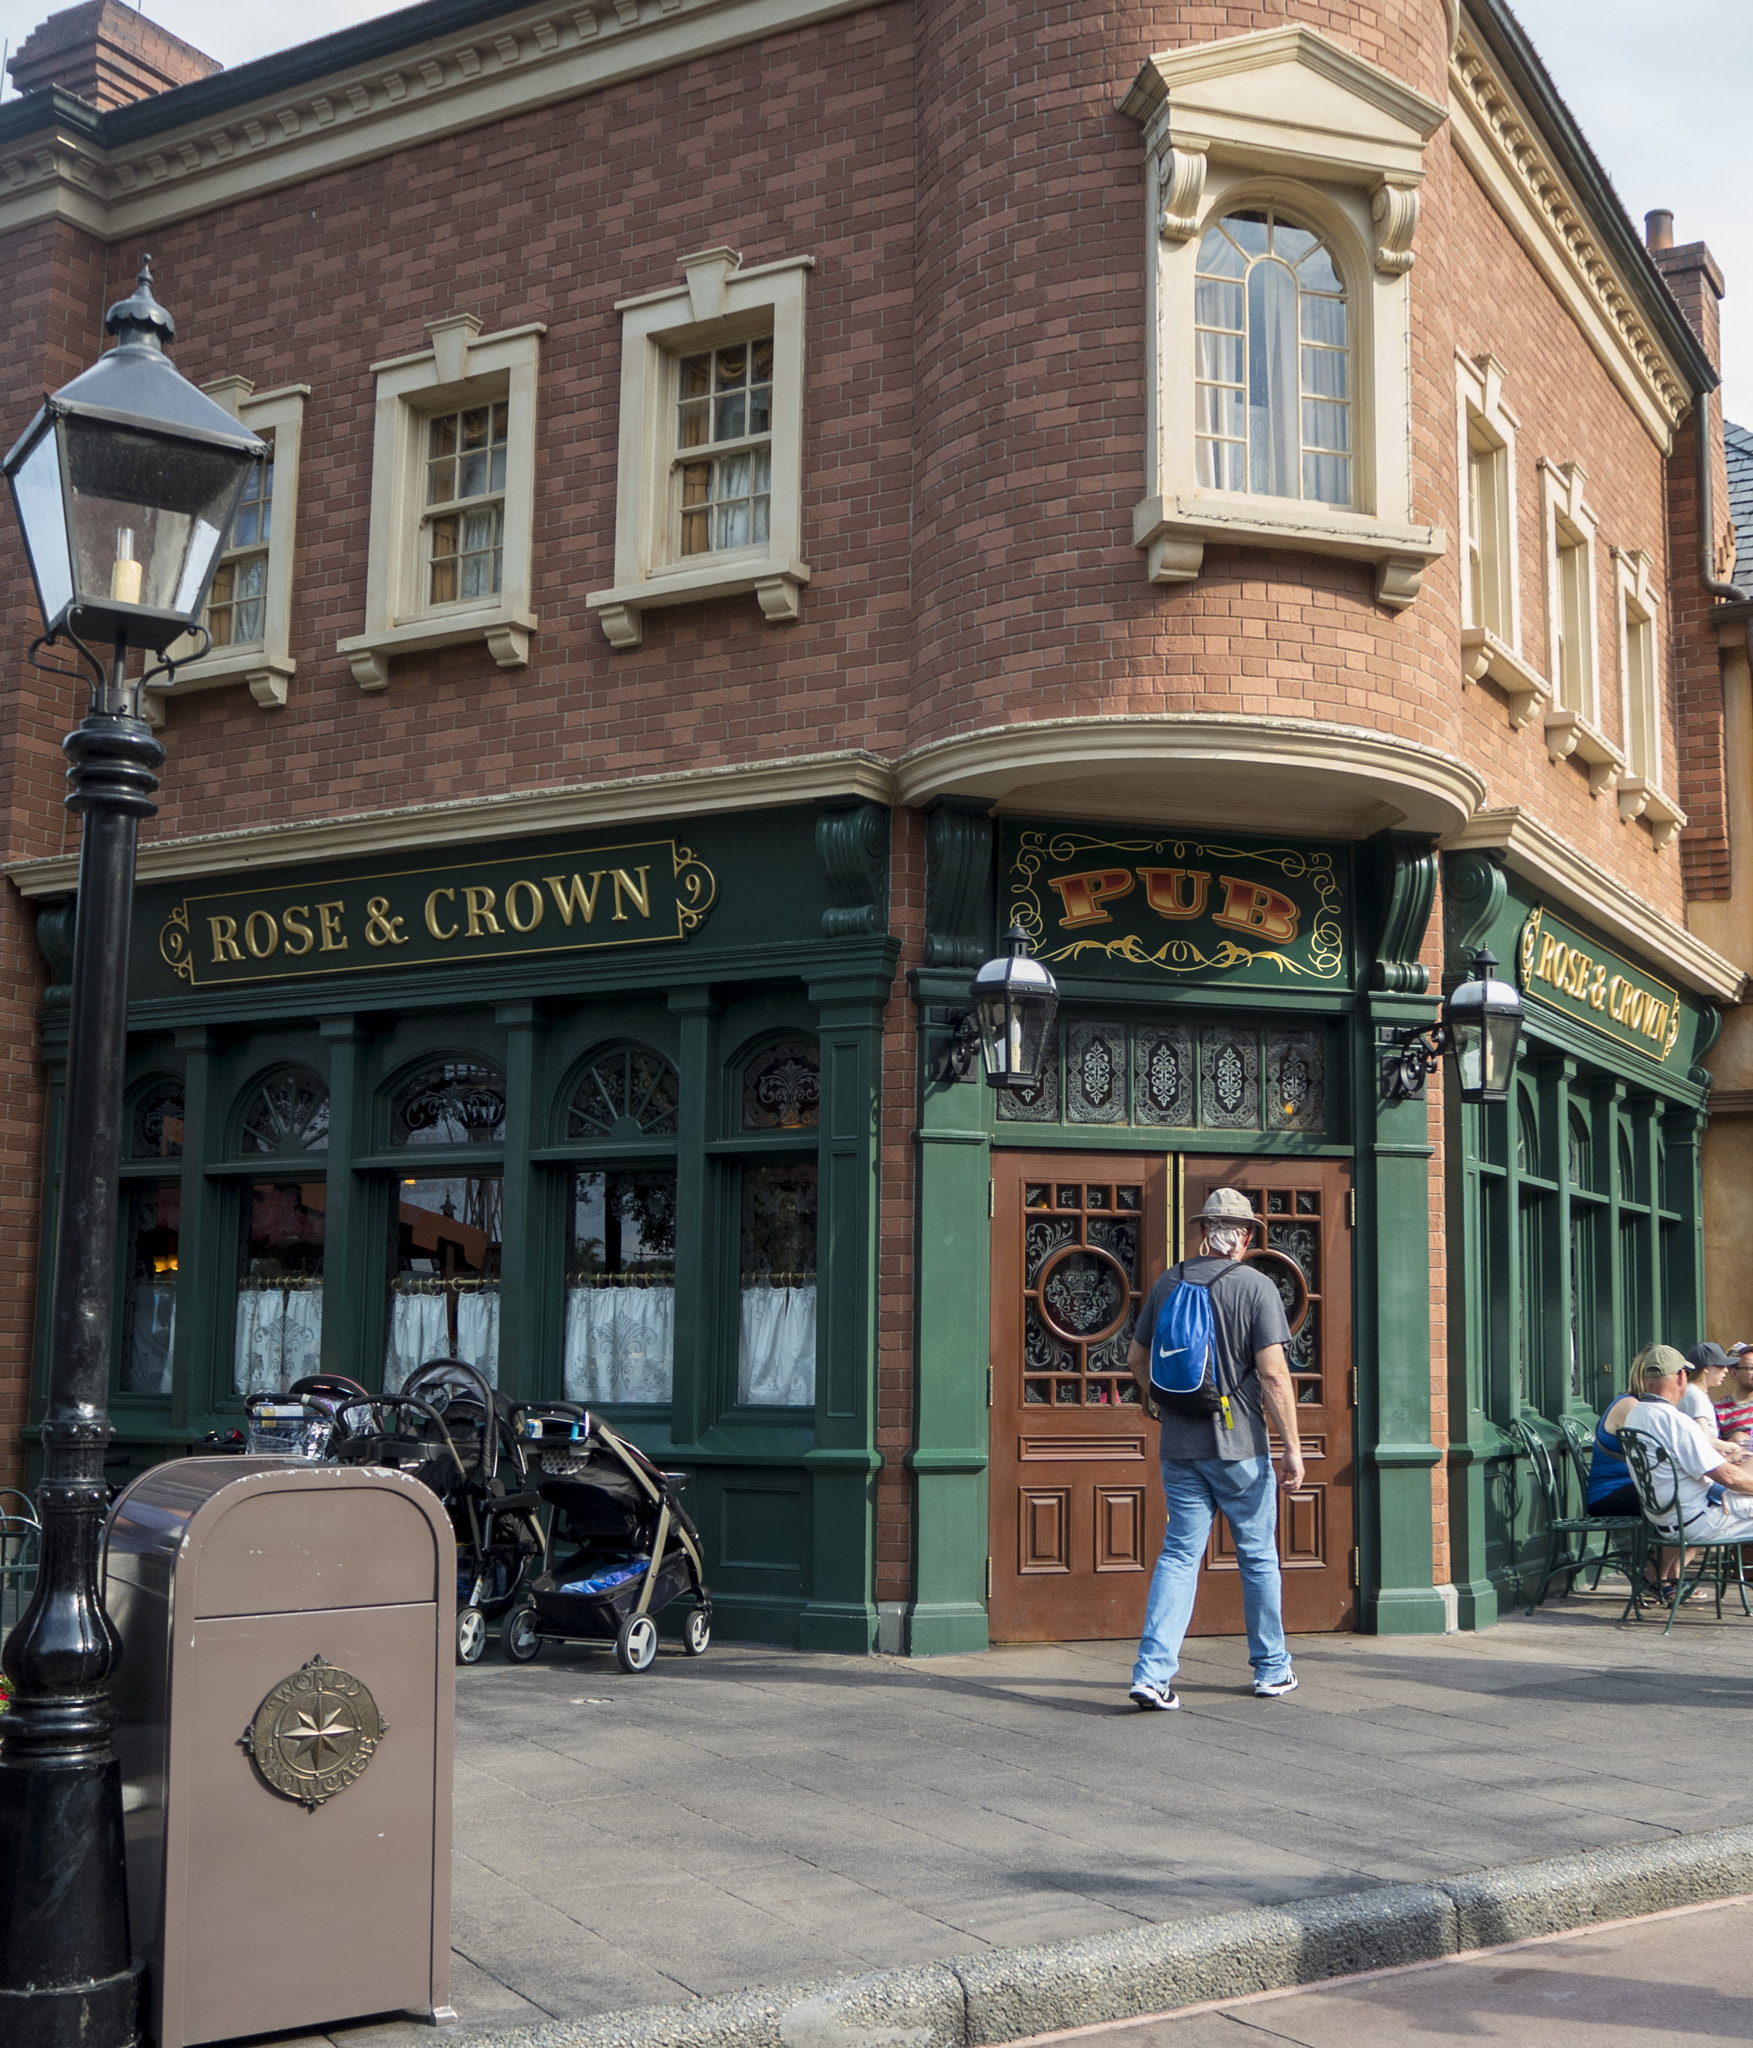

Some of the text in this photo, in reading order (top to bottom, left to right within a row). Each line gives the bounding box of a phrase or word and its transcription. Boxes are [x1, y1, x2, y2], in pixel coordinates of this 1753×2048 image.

[207, 865, 652, 963] ROSE & CROWN
[685, 873, 701, 904] 9
[1047, 867, 1301, 945] PUB
[1535, 930, 1670, 1043] ROSE & CROWN
[265, 1668, 363, 1711] WORLD
[260, 1735, 378, 1799] SHOWCASE
